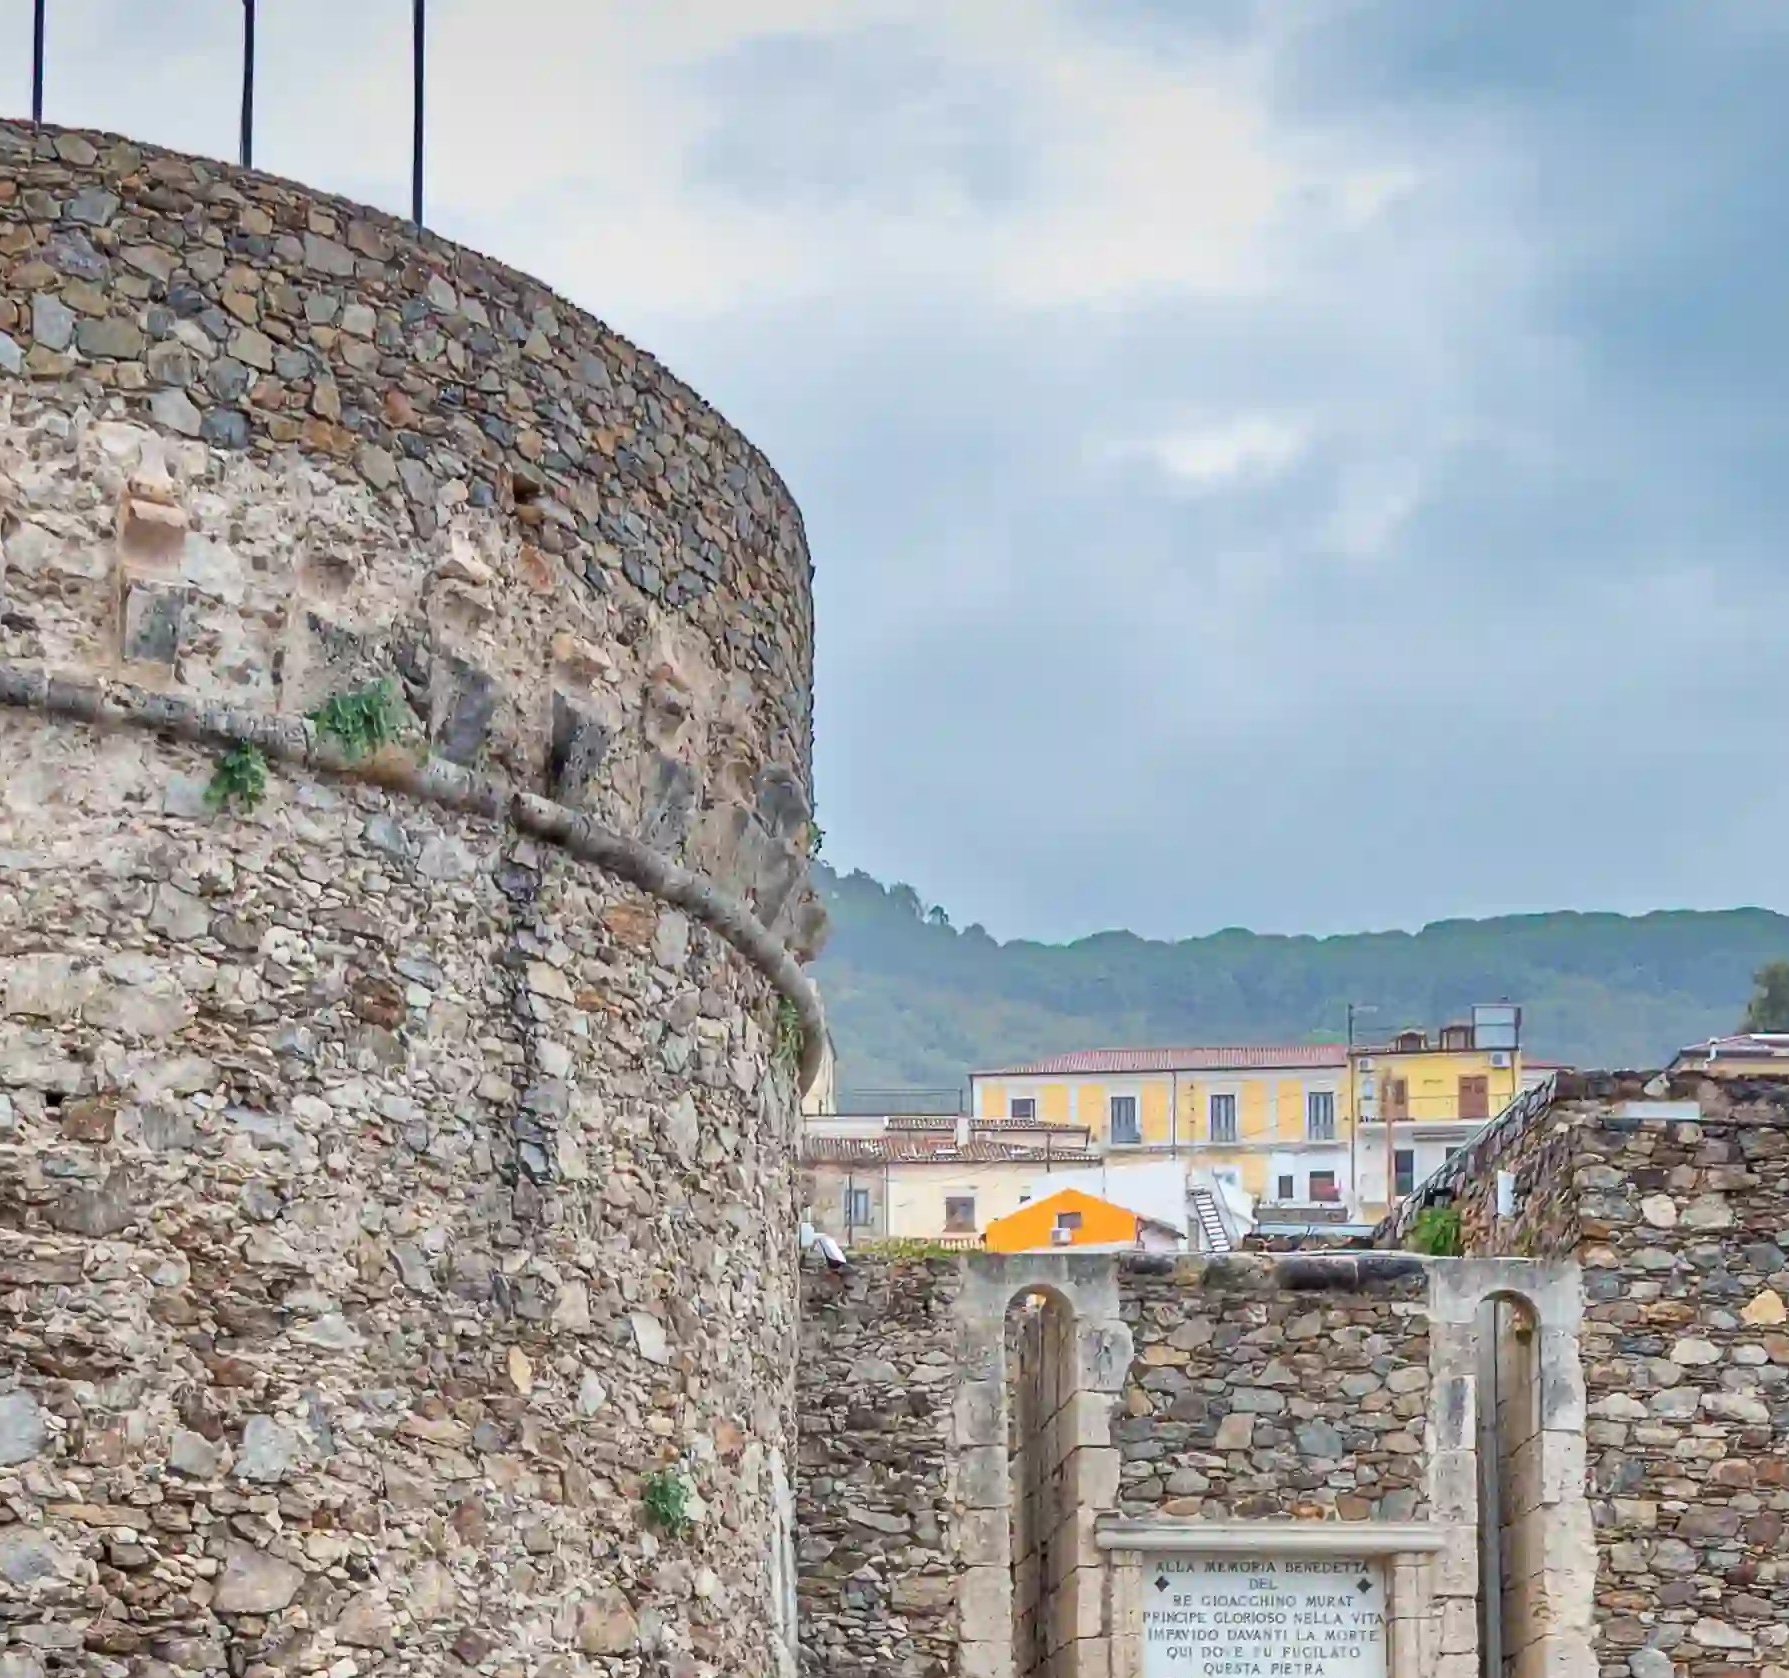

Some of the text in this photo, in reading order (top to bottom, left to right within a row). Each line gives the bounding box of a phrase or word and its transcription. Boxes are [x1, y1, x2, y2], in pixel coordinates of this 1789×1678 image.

[1155, 1562, 1370, 1573] ALLA MEMORIA BENEDETTA
[1248, 1578, 1278, 1590] DEL
[1173, 1595, 1355, 1608] RE GIOACCHINO MURAT
[1142, 1612, 1385, 1625] PRINCIPE GLORIOSO NELLA VITA
[1148, 1629, 1380, 1642] IMPAVIDO DAVANTI LA MORTE
[1166, 1647, 1193, 1659] QUI
[1201, 1647, 1243, 1659] DOE
[1282, 1647, 1361, 1659] FUCILATO
[1203, 1663, 1324, 1676] QUESTA PIETRA
